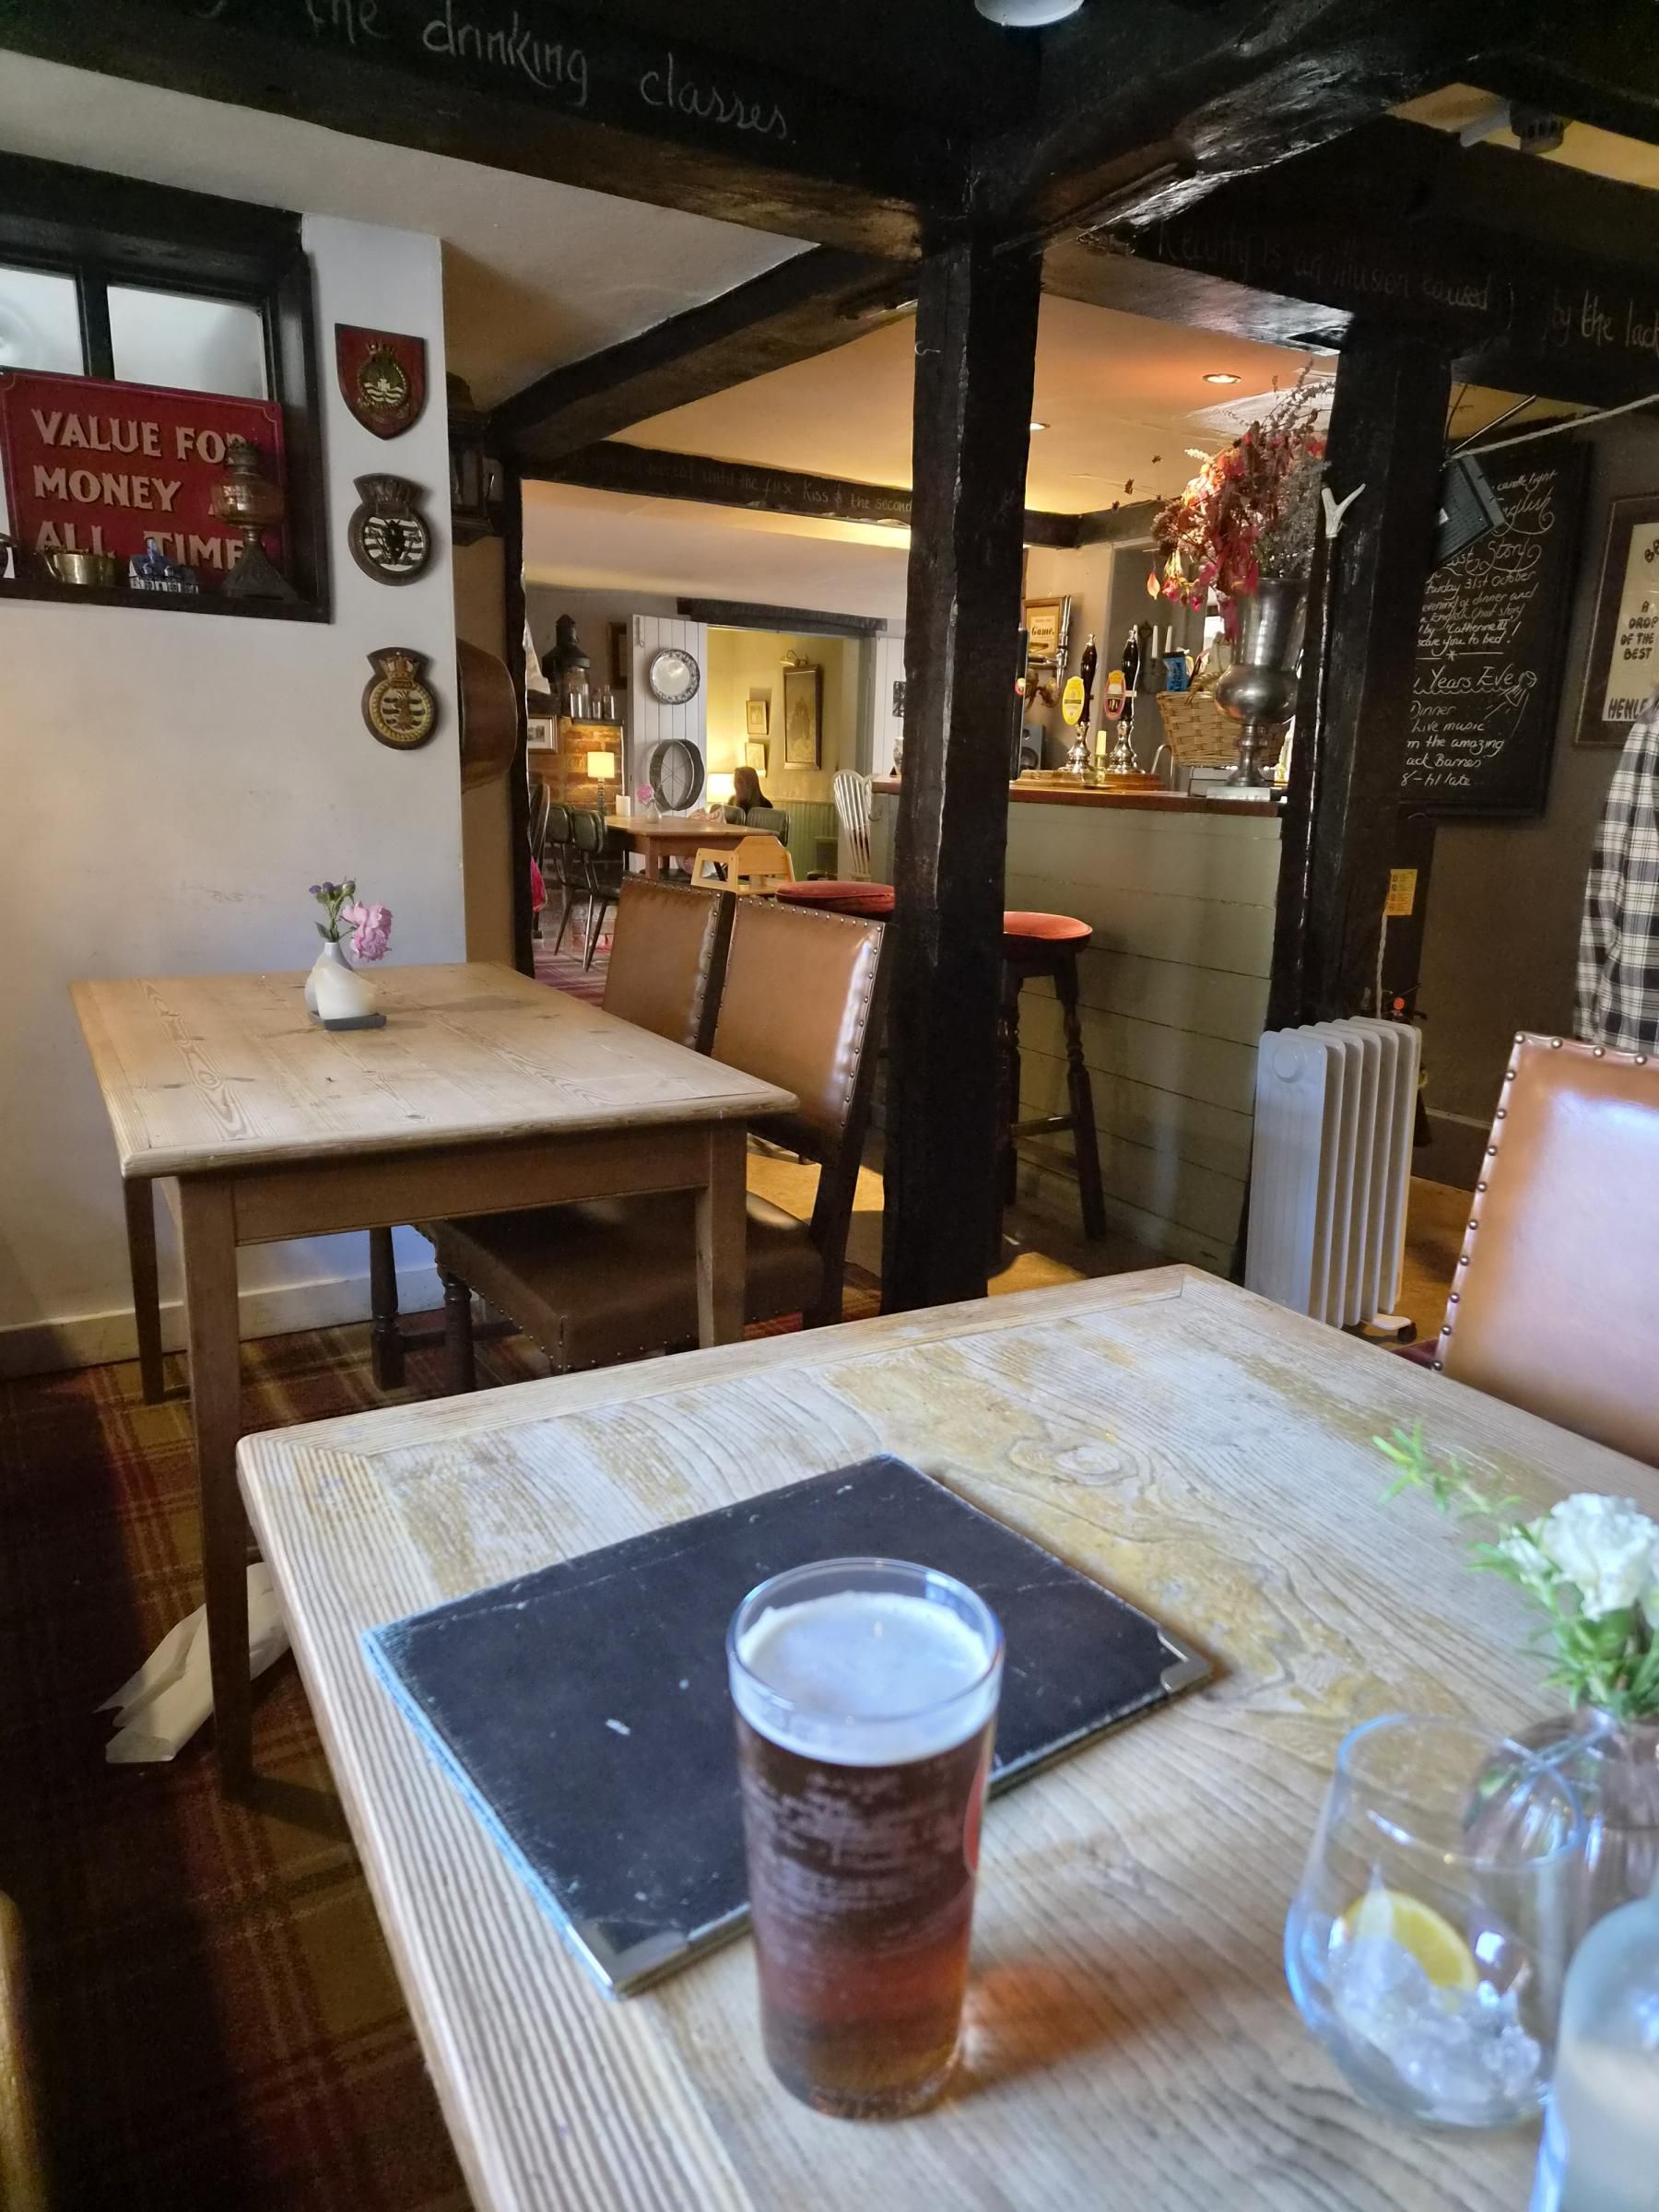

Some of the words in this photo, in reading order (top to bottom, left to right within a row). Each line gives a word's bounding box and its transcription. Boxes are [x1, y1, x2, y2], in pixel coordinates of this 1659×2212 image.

[422, 0, 592, 108] drinking
[1581, 288, 1614, 347] the
[31, 408, 162, 458] VALUE
[32, 465, 182, 512] MONEY
[850, 493, 870, 510] the
[1491, 570, 1537, 587] October
[1641, 600, 1650, 613] A
[1629, 616, 1659, 629] DROP
[1467, 633, 1479, 645] to
[1620, 632, 1634, 646] OF
[1637, 632, 1655, 644] THE
[1623, 647, 1653, 661] BEST
[1430, 665, 1473, 689] Years
[1477, 663, 1515, 687] Eve
[1409, 700, 1457, 720] Dinner
[1442, 722, 1486, 732] music
[1426, 735, 1446, 748] the
[1450, 738, 1505, 759] amazing
[1443, 772, 1472, 786] late
